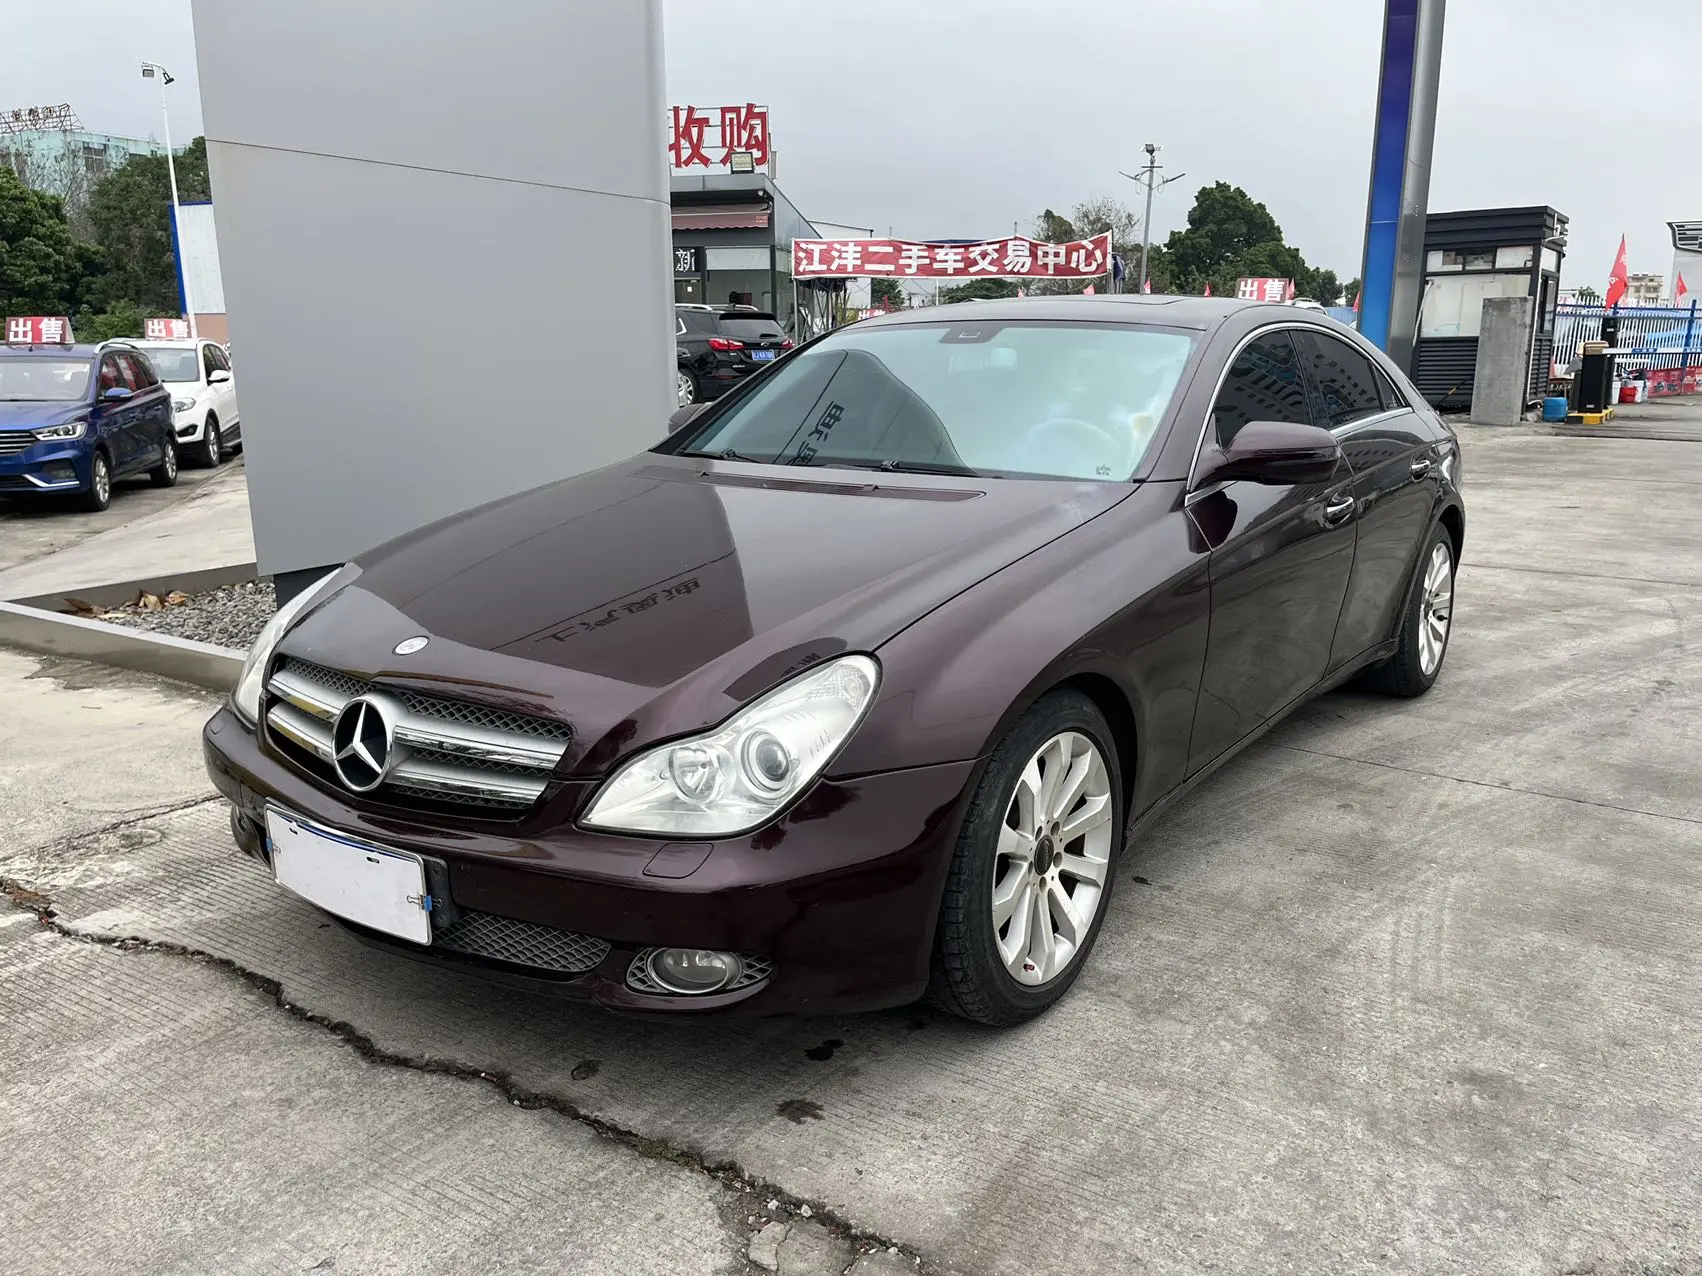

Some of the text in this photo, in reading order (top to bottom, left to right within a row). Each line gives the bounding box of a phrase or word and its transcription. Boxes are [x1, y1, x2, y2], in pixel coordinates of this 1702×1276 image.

[668, 103, 768, 168] 收购
[1238, 279, 1285, 302] 出售
[9, 317, 64, 343] 出售
[147, 319, 189, 338] 出售
